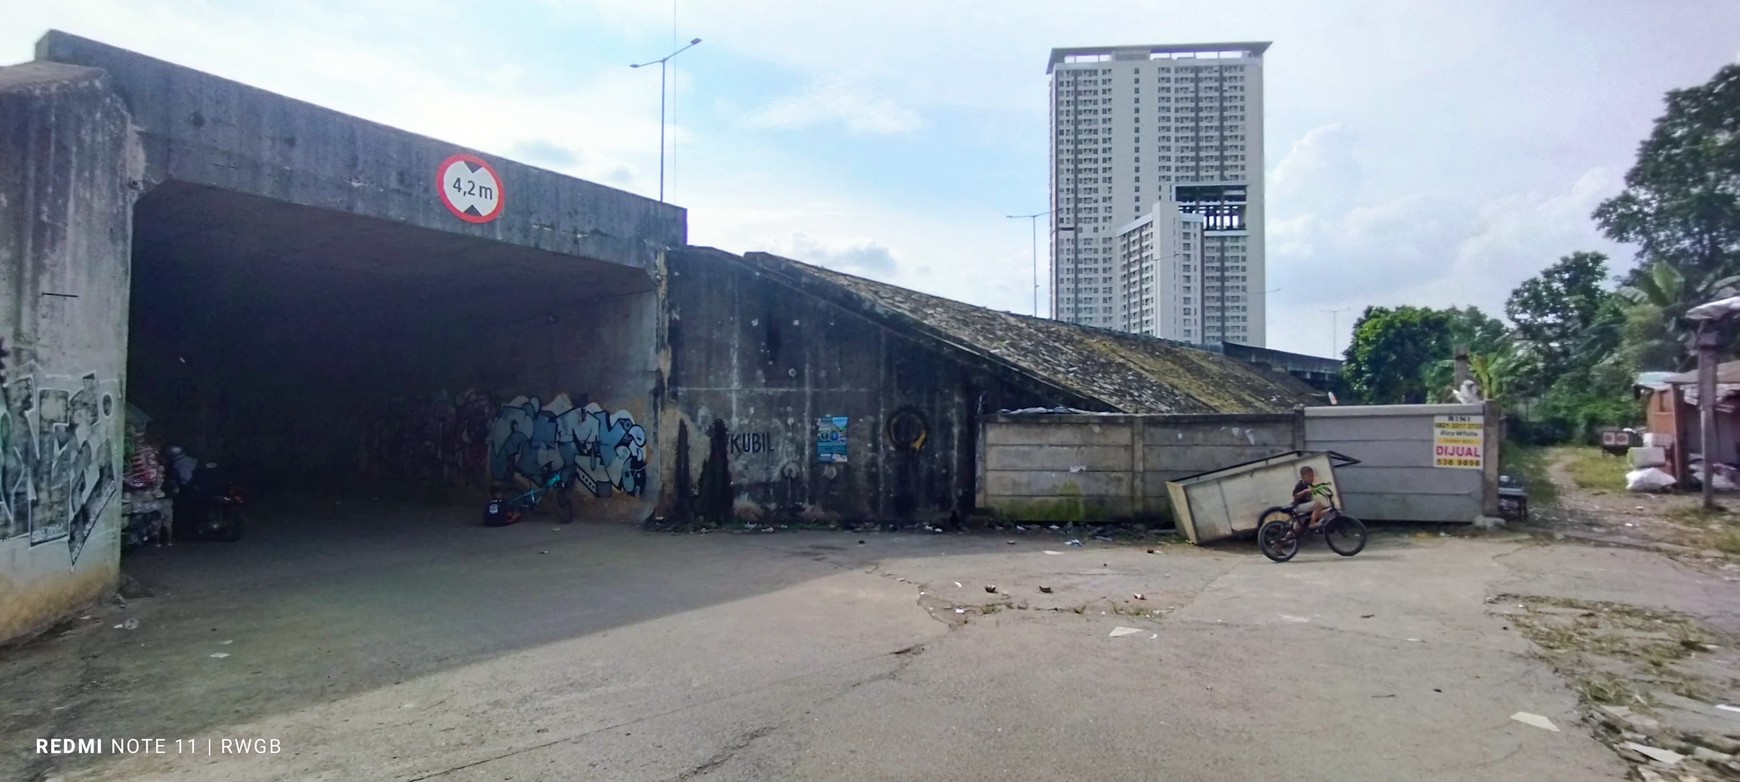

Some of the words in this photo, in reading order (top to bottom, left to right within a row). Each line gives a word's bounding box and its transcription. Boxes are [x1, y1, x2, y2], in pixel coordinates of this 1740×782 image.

[452, 177, 476, 197] 4,2
[479, 185, 493, 200] m
[730, 432, 775, 455] KUBIL
[1436, 446, 1481, 457] DIJUAL
